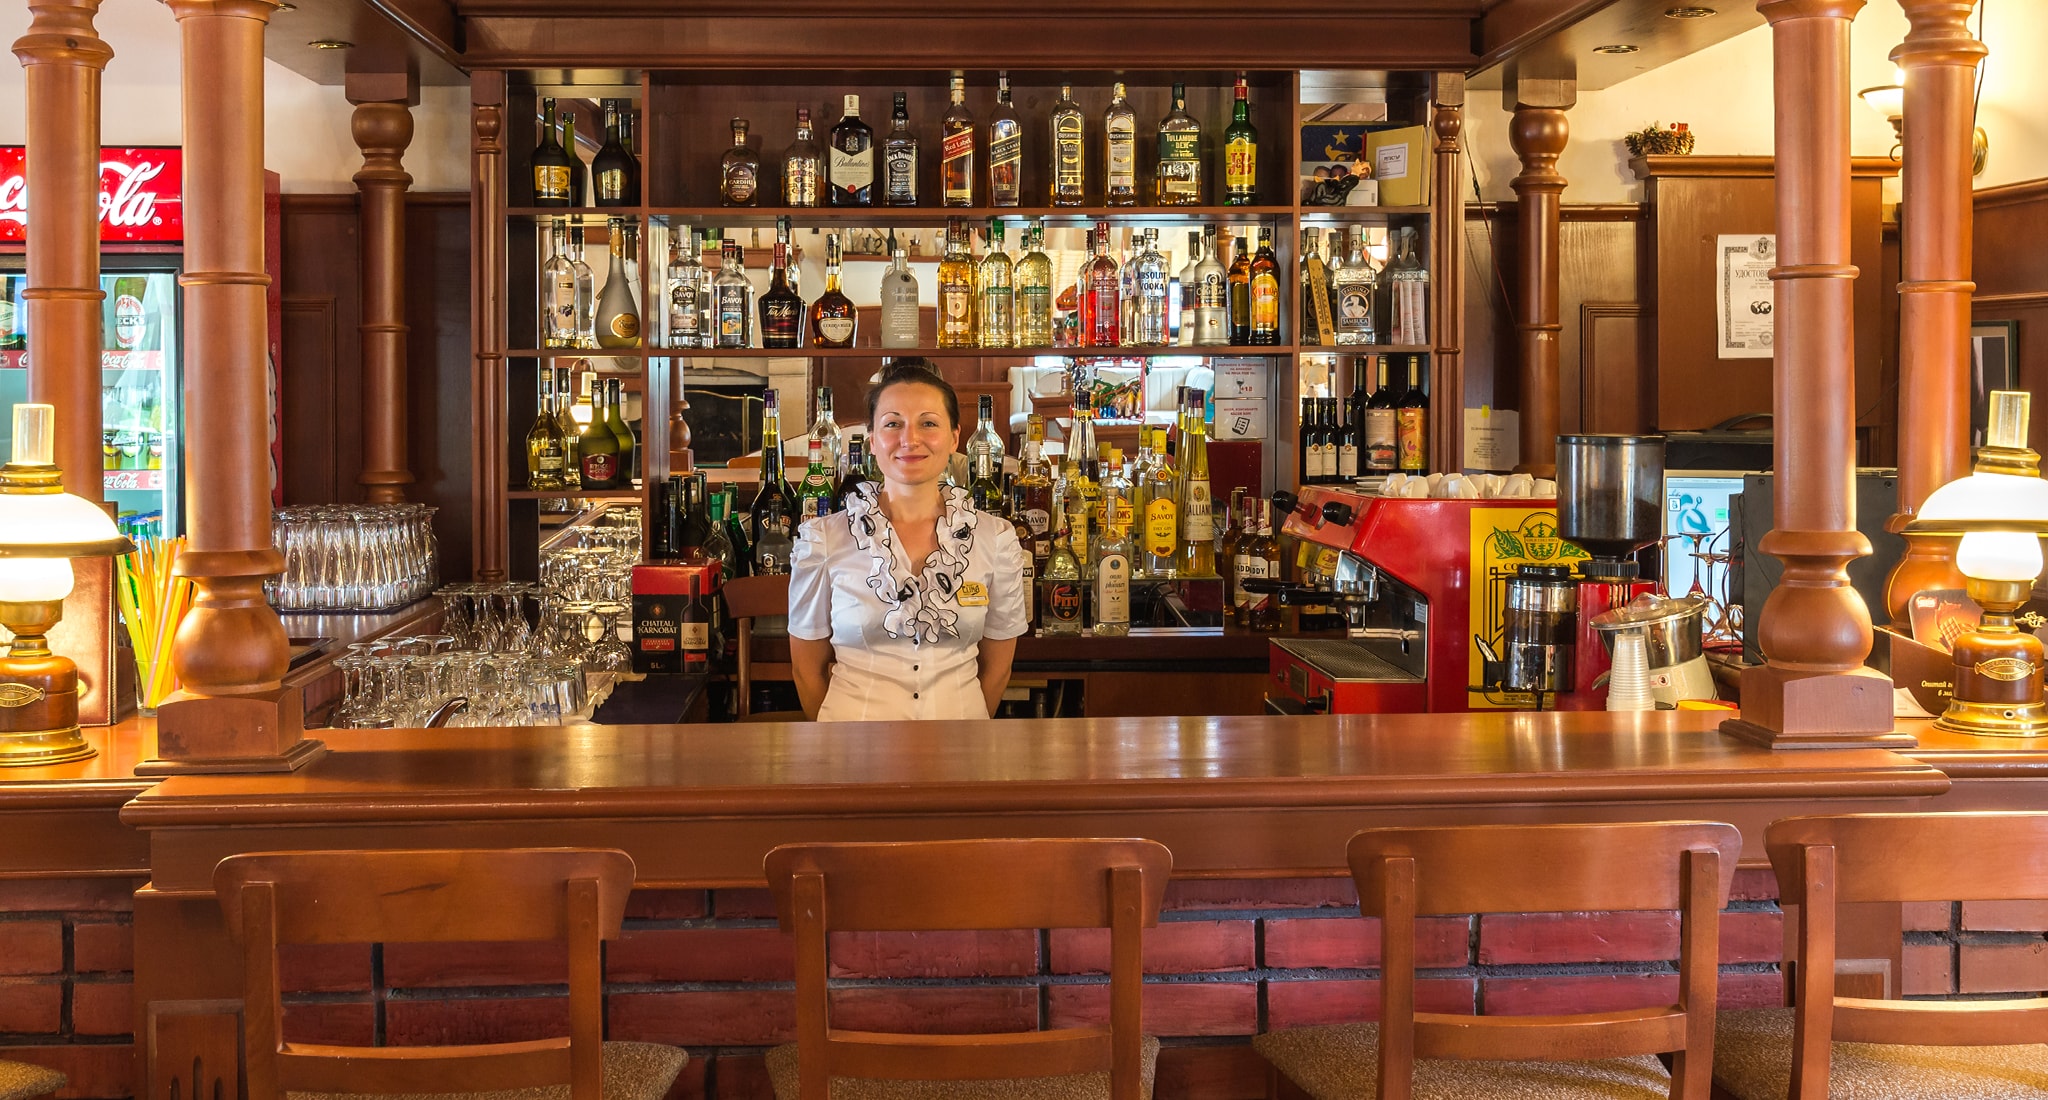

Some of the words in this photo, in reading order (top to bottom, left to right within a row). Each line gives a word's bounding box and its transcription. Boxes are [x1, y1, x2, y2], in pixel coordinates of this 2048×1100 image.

[1165, 133, 1198, 142] TULLAMORE
[944, 143, 956, 152] Red
[956, 137, 972, 148] Label
[833, 156, 870, 168] Ballantine's
[1139, 282, 1164, 291] VODKA
[673, 290, 695, 298] SAVOY
[721, 296, 743, 305] SAVOY
[1098, 509, 1131, 520] GOON'S
[1150, 513, 1174, 521] SAVOY
[637, 626, 678, 634] KARNOBAT
